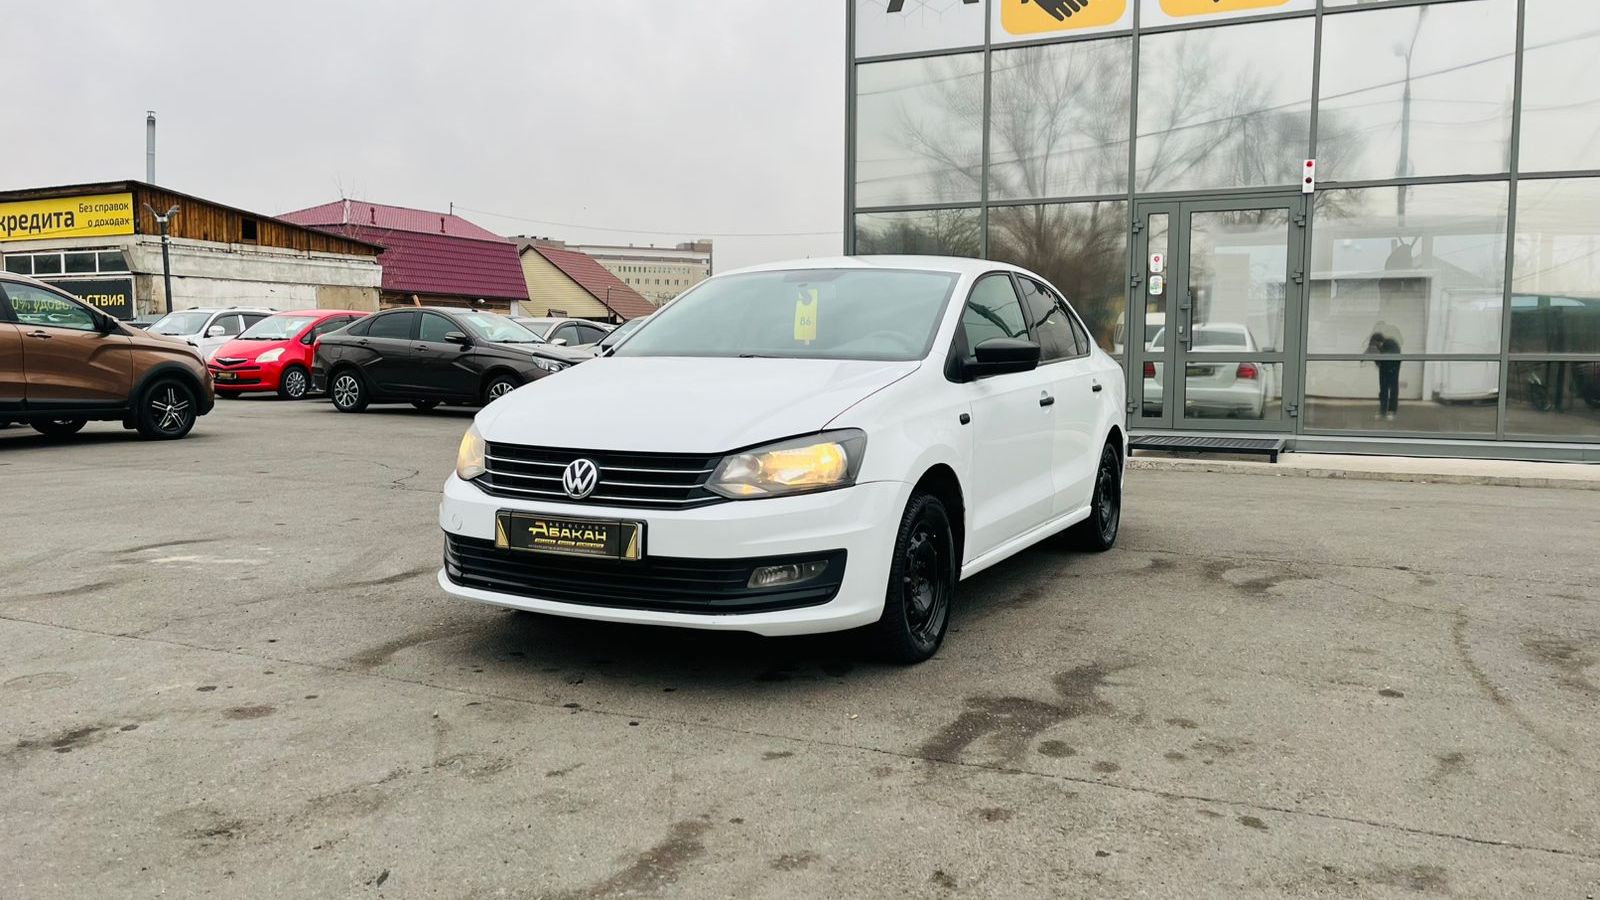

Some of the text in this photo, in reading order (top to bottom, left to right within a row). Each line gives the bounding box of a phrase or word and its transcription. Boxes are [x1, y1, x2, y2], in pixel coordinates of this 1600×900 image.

[79, 203, 129, 213] Без справок
[0, 211, 75, 237] кредита
[88, 217, 130, 228] о доходах
